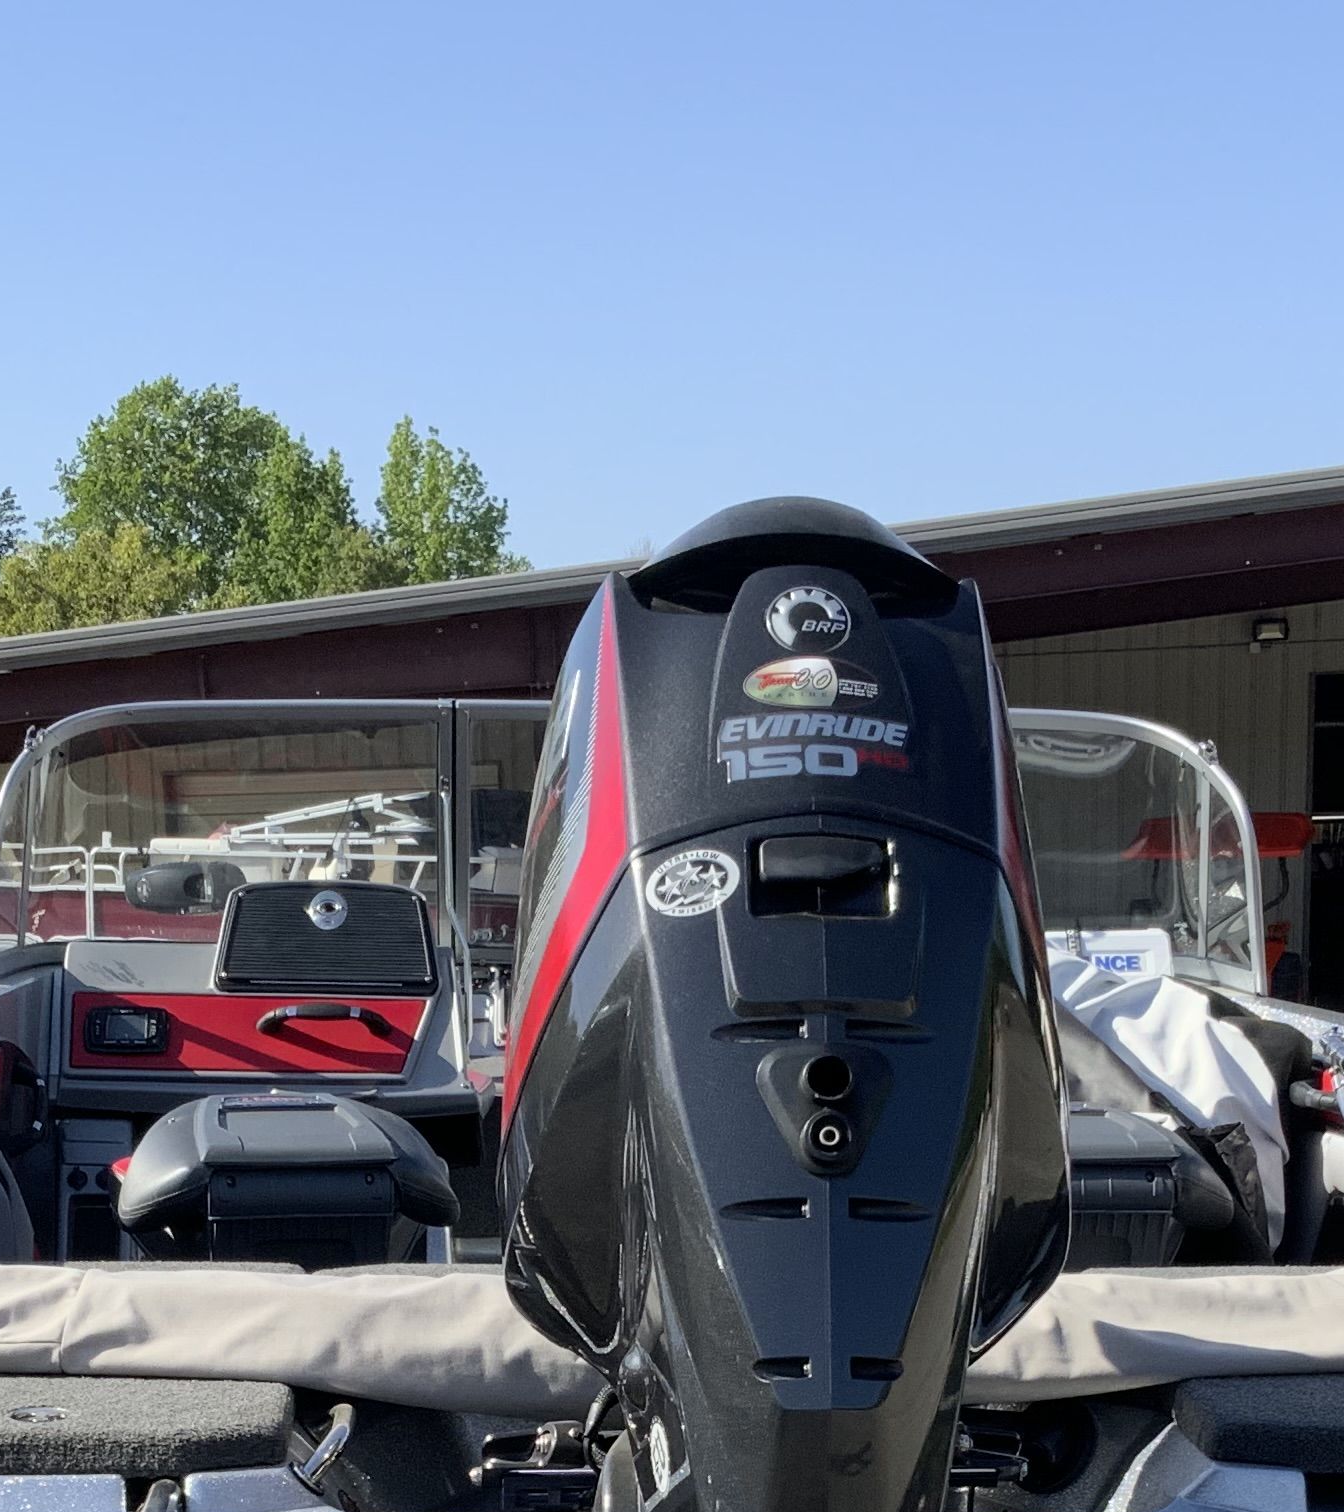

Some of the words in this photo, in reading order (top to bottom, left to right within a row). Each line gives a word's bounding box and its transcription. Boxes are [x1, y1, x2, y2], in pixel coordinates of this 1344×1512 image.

[801, 619, 846, 634] BRP
[720, 713, 908, 746] EVINRUDE
[721, 744, 858, 783] 150
